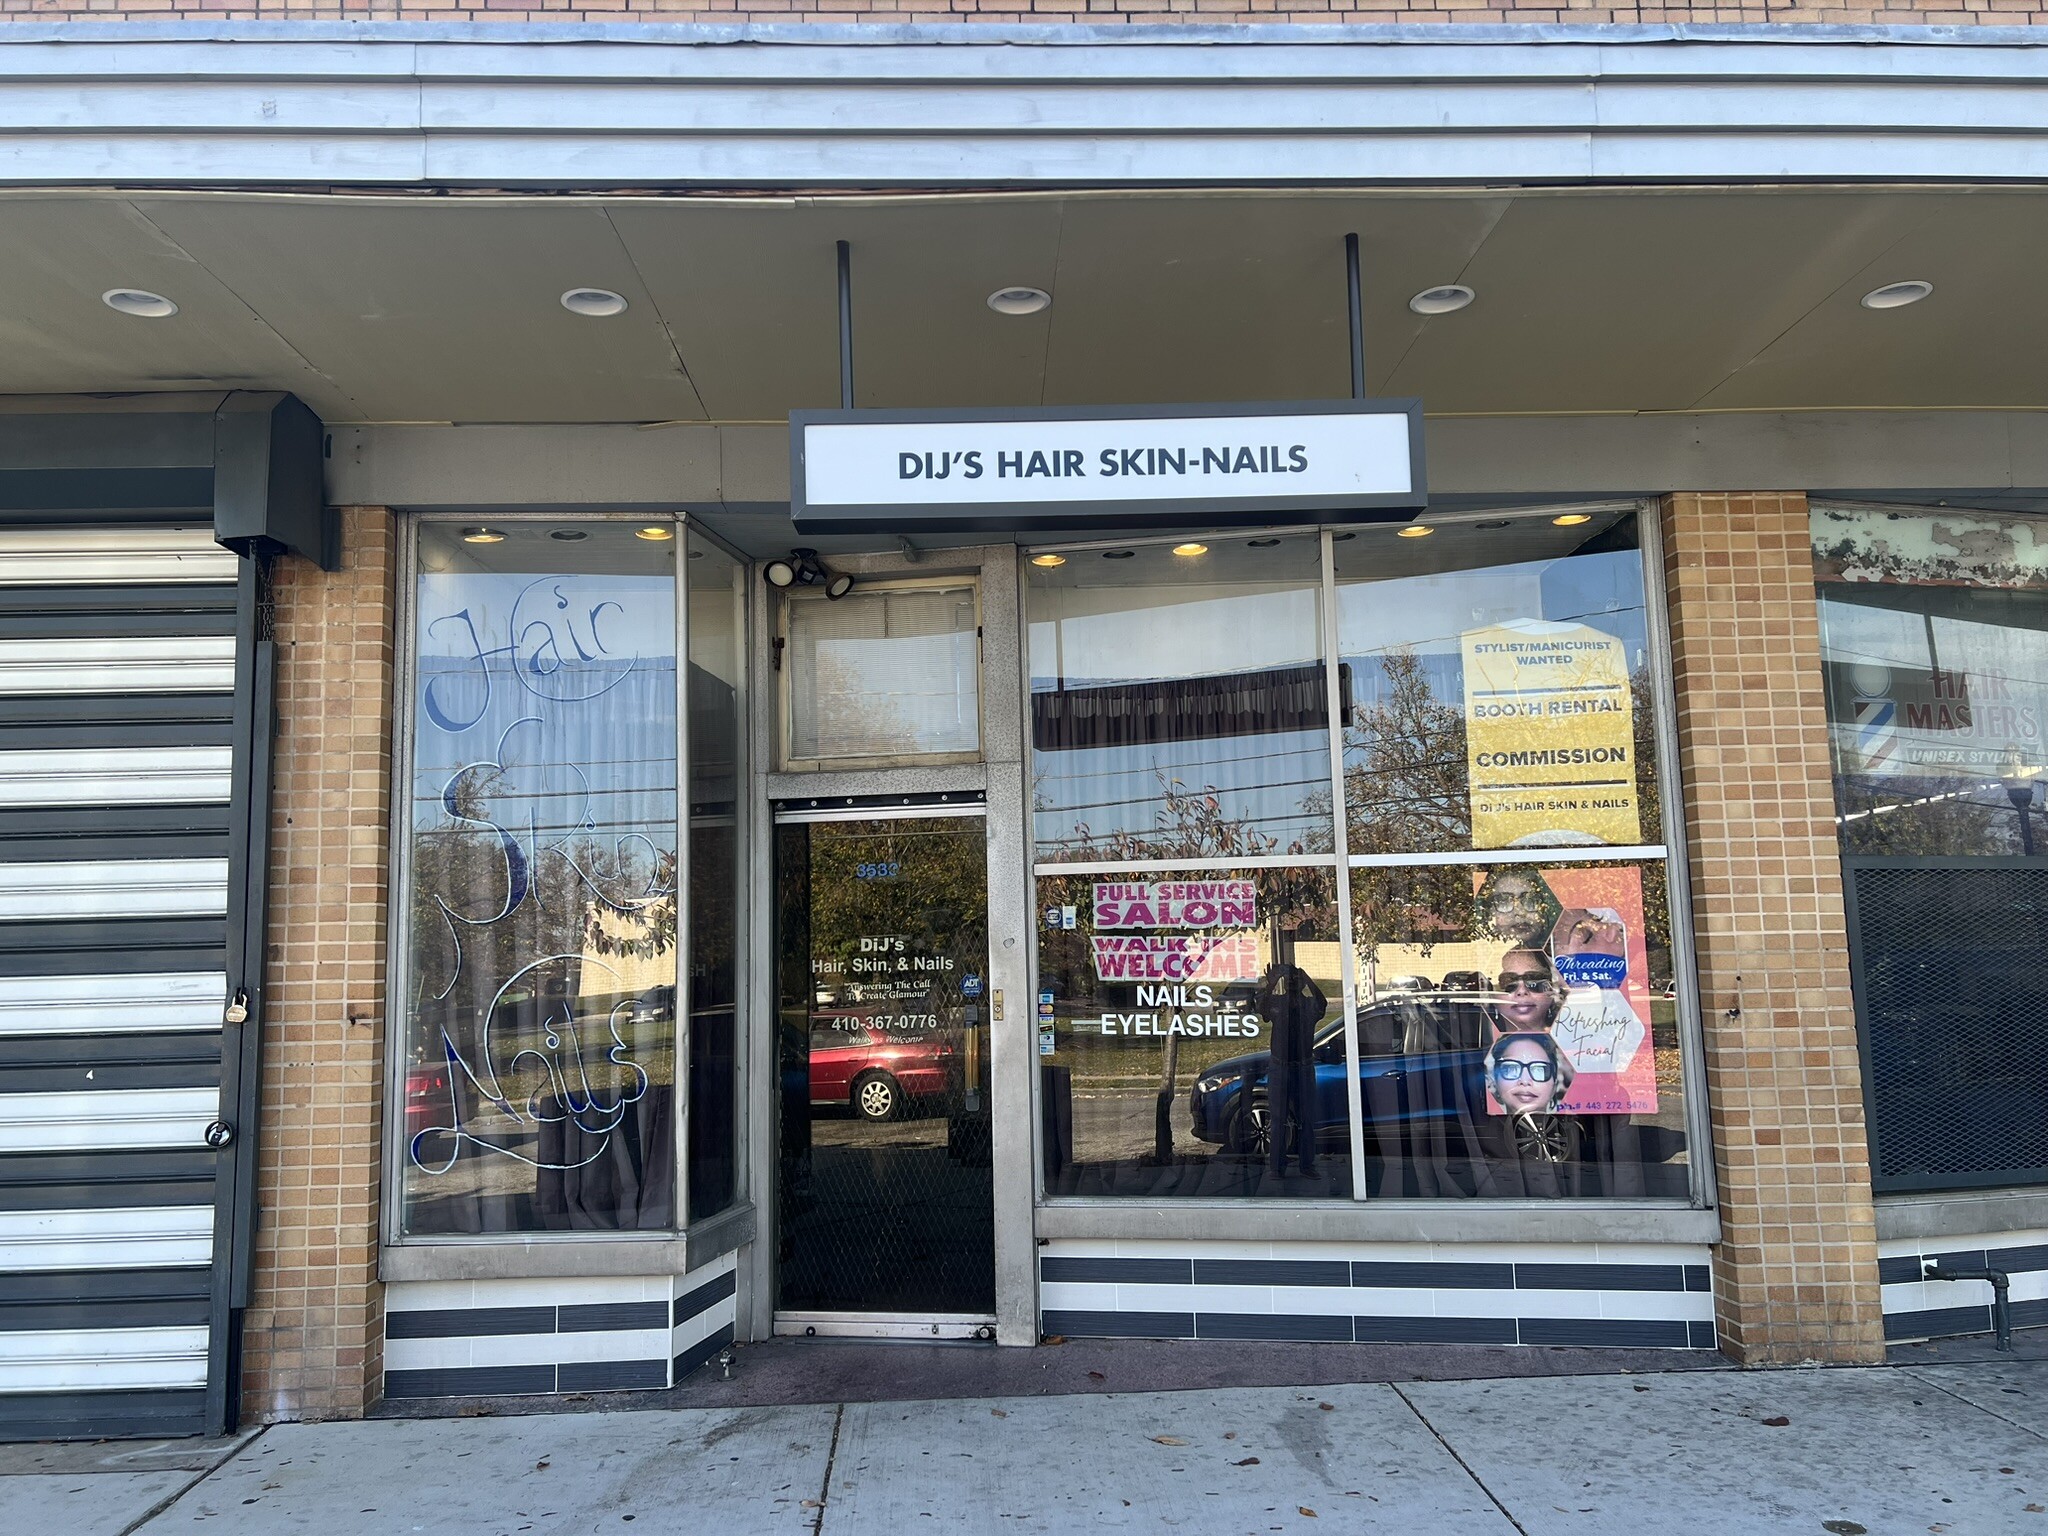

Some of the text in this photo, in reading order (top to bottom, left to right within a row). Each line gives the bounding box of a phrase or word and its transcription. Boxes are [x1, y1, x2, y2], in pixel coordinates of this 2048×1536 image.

[898, 444, 1309, 480] DIJ'S HAIR SKIN-NAILS
[424, 575, 638, 733] Hair
[1474, 641, 1611, 654] STYLIST/MANICURIST
[1516, 655, 1573, 666] WANTED
[1928, 666, 2013, 700] HAIR
[1474, 698, 1623, 718] BOOTH RENTAL
[1905, 703, 2038, 740] MASTERS
[1476, 747, 1627, 768] COMMISSION
[1912, 750, 1966, 763] UNISEX
[1515, 801, 1545, 812] HAIR
[1548, 800, 1578, 810] SKIN
[1581, 800, 1589, 809] &
[1593, 799, 1630, 809] NAILS
[1096, 882, 1255, 901] FULL SERVICE
[1096, 901, 1255, 926] SALON
[860, 936, 905, 952] DiJ's
[1096, 937, 1257, 953] WALK-INS
[811, 955, 954, 975] Hair, Skin, & Nails
[1098, 953, 1257, 980] WELCOME
[1554, 954, 1625, 972] Threading
[895, 979, 912, 990] The
[913, 979, 931, 989] Call
[964, 978, 979, 987] ADT
[1563, 971, 1612, 981] Fri. & Sat.
[860, 991, 887, 1000] Create
[1137, 985, 1213, 1007] NAILS
[831, 1014, 937, 1031] 410-367-0776
[1101, 1013, 1260, 1037] EYELASHES
[1555, 1006, 1631, 1040] Refreshing
[886, 1035, 924, 1044] Welcome
[1572, 1034, 1618, 1066] Facial
[411, 954, 648, 1174] Nails
[1586, 1101, 1601, 1109] 443
[1606, 1101, 1622, 1109] 272
